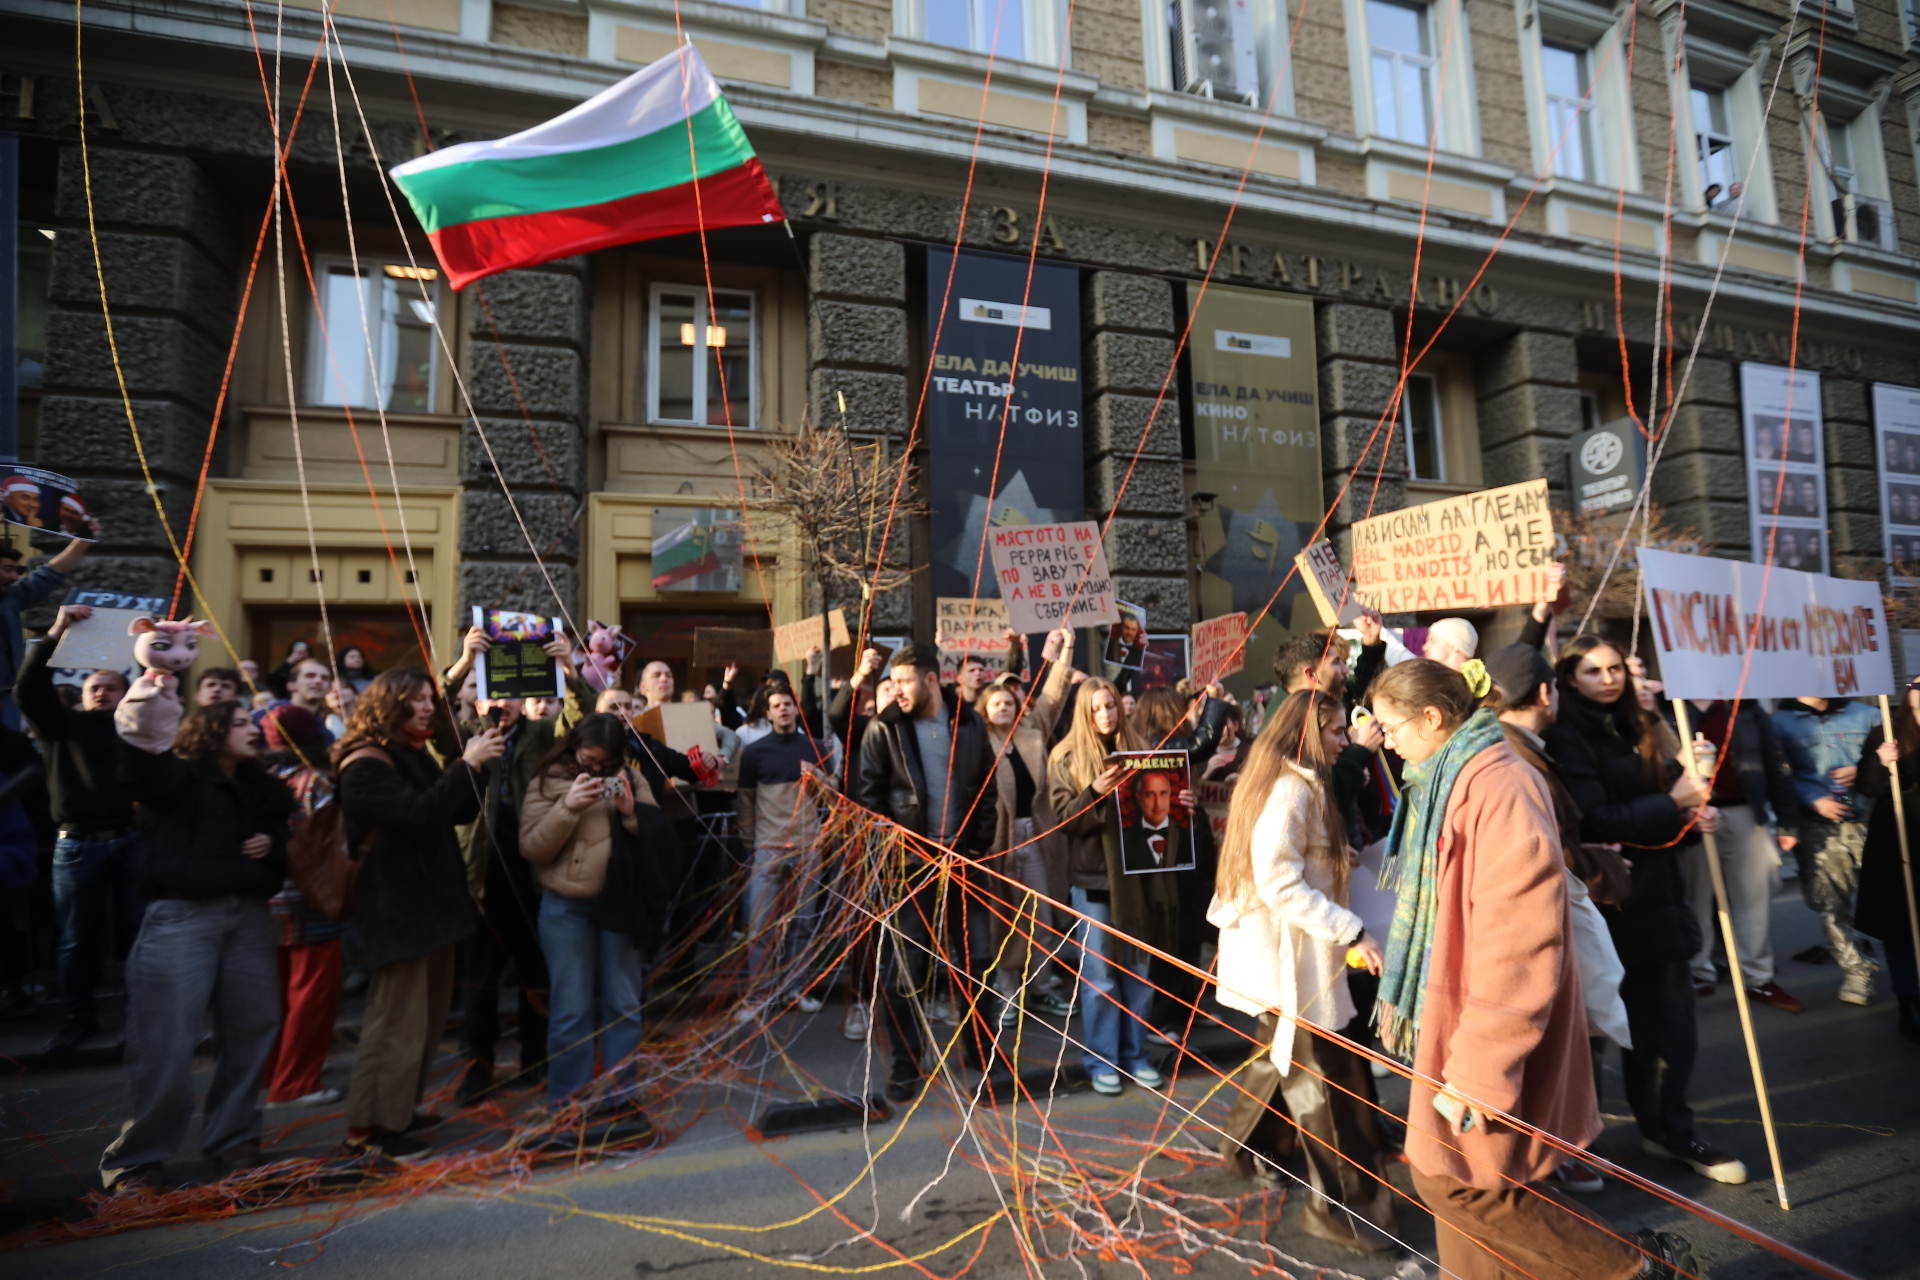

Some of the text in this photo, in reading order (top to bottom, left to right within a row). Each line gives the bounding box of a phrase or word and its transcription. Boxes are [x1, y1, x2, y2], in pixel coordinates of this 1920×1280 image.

[991, 205, 1066, 250] ЗА
[934, 353, 1078, 382] ЕЛА ДА УЧИШ
[933, 376, 1016, 399] ТЕАТЪР
[1196, 381, 1314, 405] ЕЛА ДА УЧИШ
[1197, 402, 1248, 420] КИНО
[1365, 525, 1378, 545] АЗ
[1381, 509, 1431, 543] ИСКАМ
[1440, 504, 1469, 531] ДА
[1471, 487, 1550, 526] ГЛЕДАМ
[995, 527, 1093, 546] МЯСТОТО НА
[1354, 547, 1387, 566] REAL
[1474, 530, 1491, 550] А
[1504, 519, 1543, 547] НЕ
[1010, 548, 1051, 565] PEPPA
[1309, 543, 1339, 568] НЕ
[1001, 567, 1020, 584] ПО
[1032, 564, 1068, 582] BABY
[1356, 566, 1389, 587] REAL
[1486, 550, 1510, 571] НО
[1011, 578, 1112, 601] А НЕ В НАРОДНО
[75, 591, 166, 612] ГРУХ!
[941, 602, 956, 616] НЕ
[1124, 757, 1185, 769] РАДЕЦЪТ
